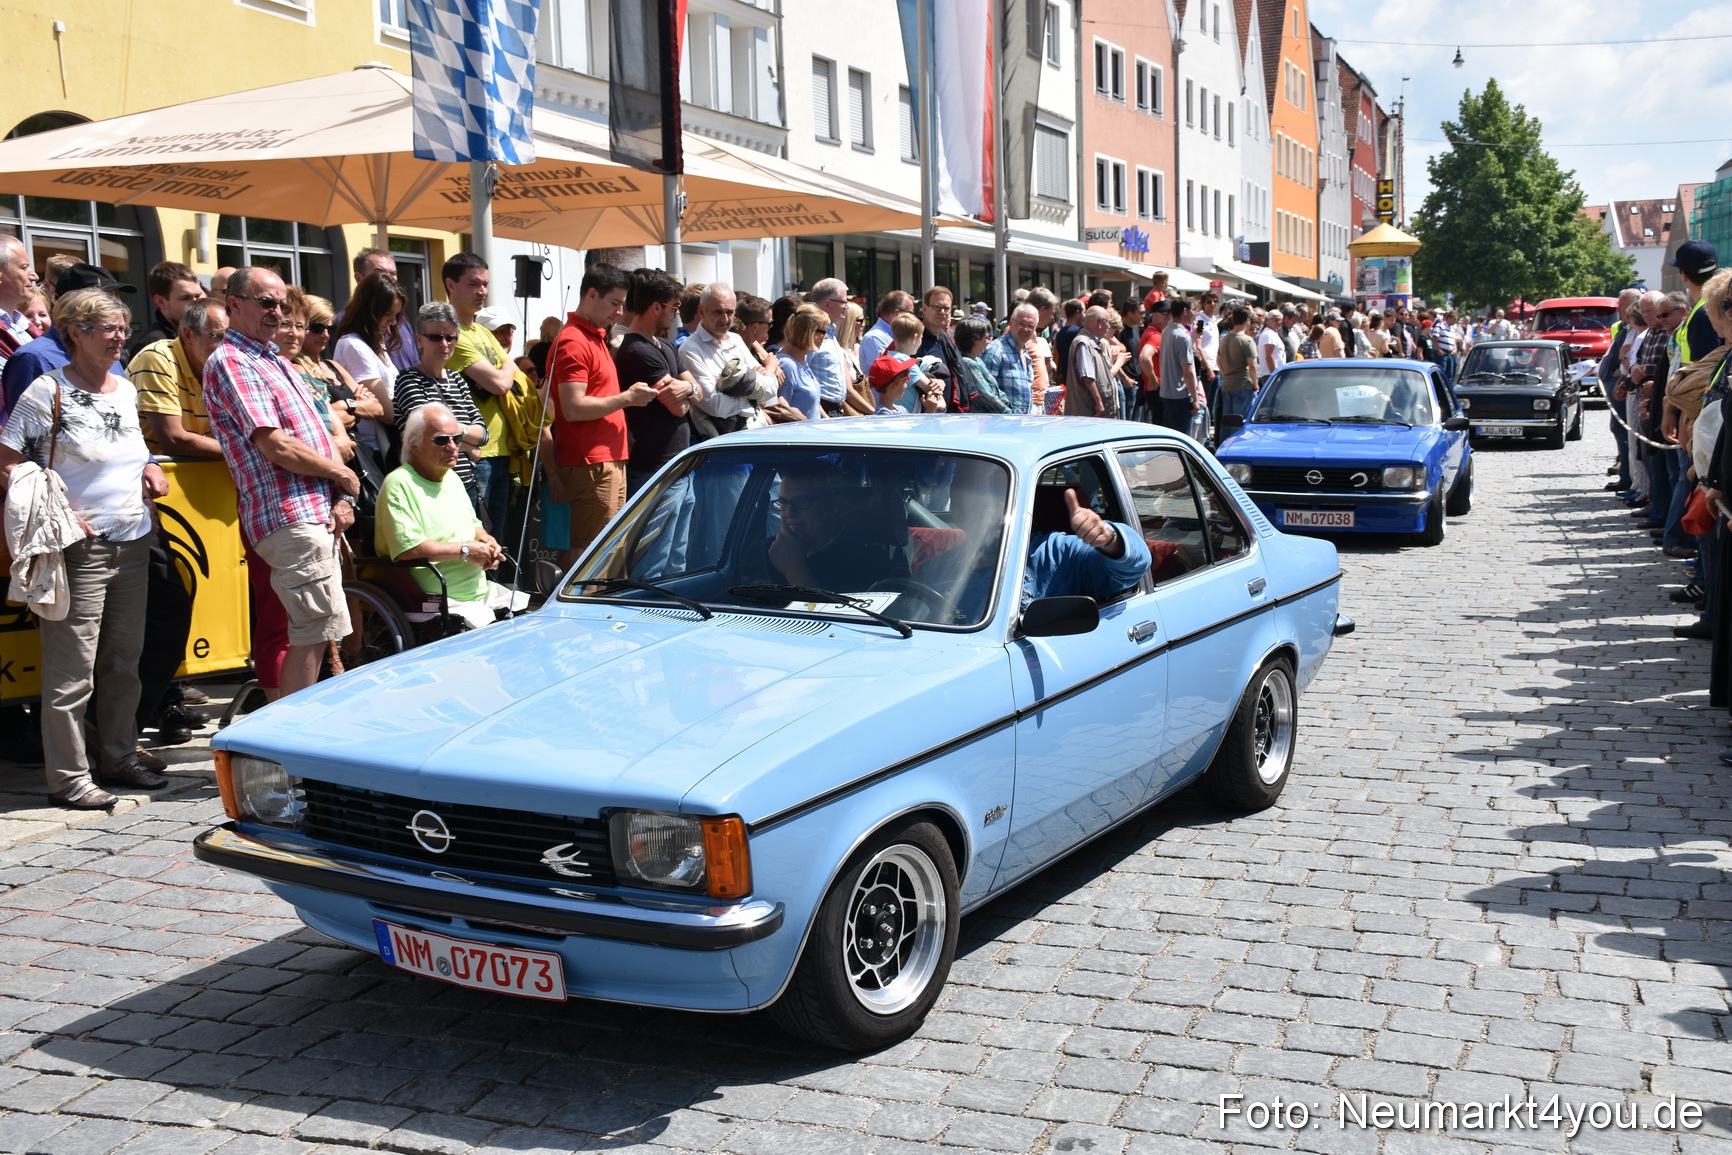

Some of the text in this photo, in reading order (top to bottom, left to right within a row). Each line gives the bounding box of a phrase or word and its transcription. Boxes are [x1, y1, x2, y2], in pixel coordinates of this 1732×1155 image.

[117, 128, 293, 146] Neumarkter
[48, 137, 299, 161] Lammsbräu
[1286, 512, 1351, 525] NM 07038
[393, 930, 554, 993] NM 07073
